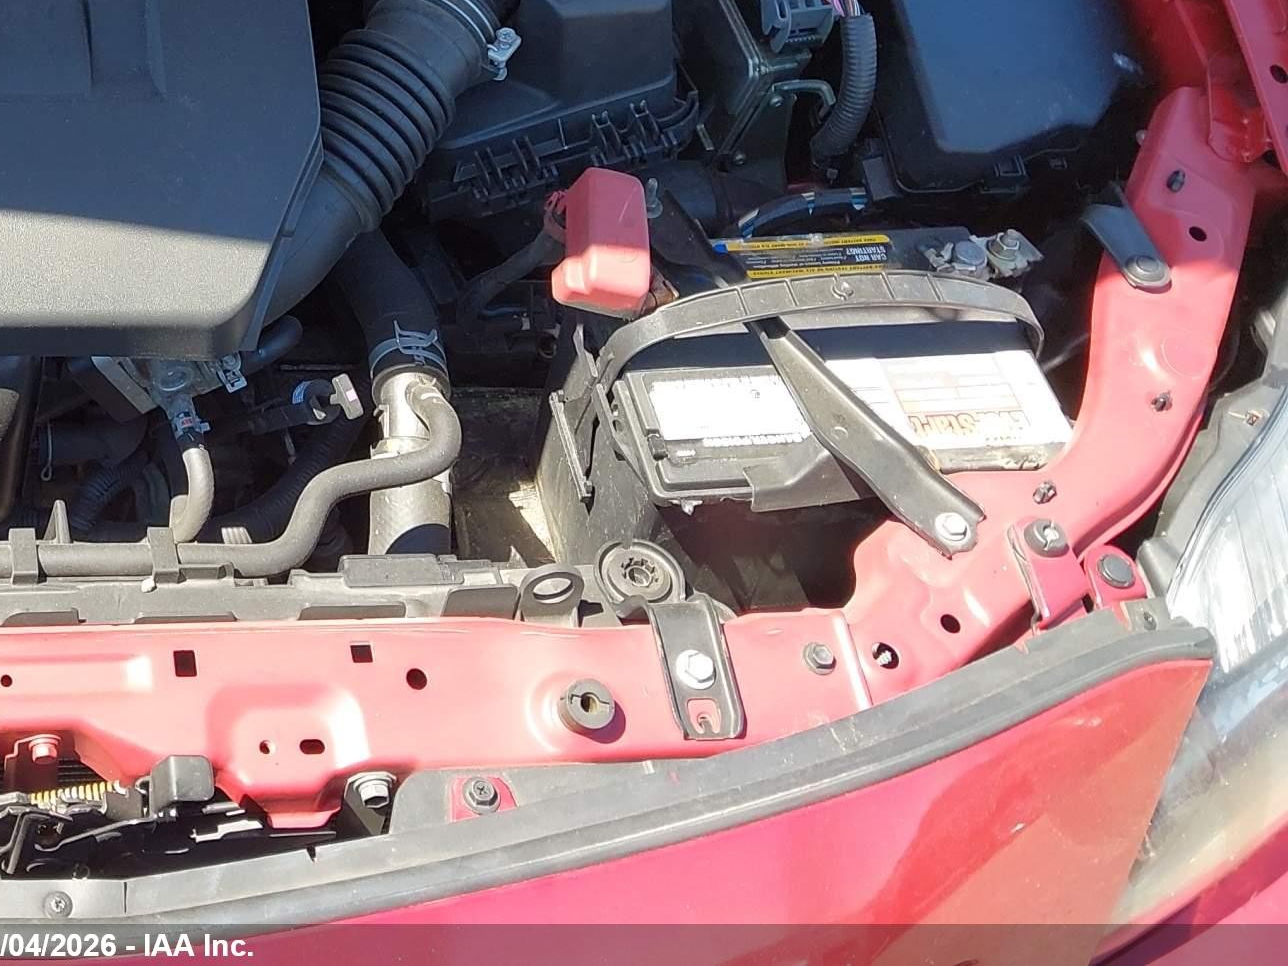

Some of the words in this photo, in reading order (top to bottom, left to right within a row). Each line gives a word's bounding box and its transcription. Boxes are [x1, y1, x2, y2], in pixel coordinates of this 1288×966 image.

[845, 245, 887, 256] STARTING?
[855, 254, 872, 262] NOT
[871, 253, 887, 262] CAR
